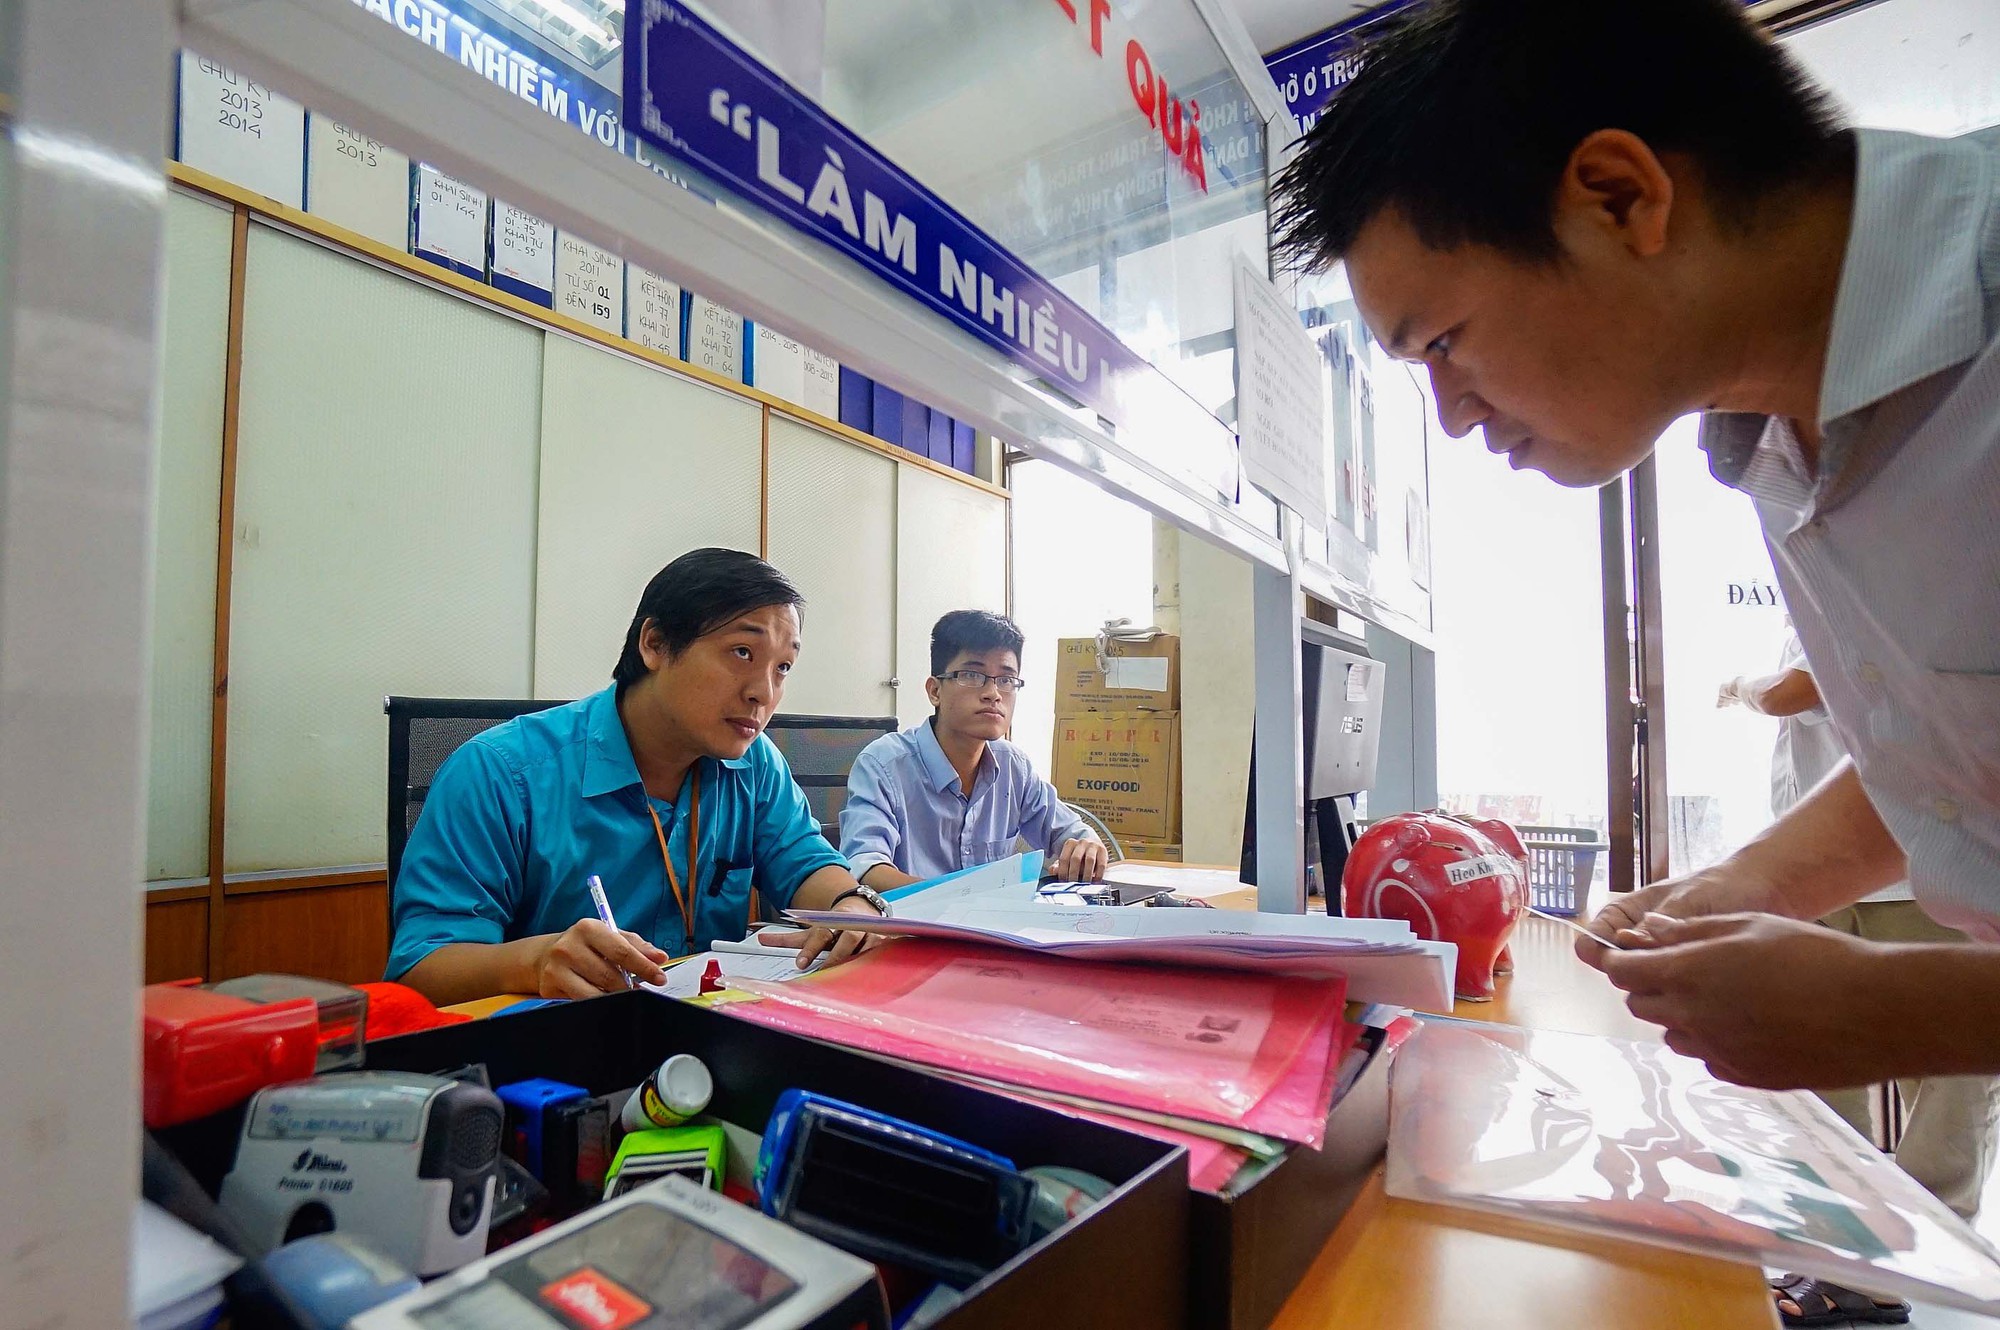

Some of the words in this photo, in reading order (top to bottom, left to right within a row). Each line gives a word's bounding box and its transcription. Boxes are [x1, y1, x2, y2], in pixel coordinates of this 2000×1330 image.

[220, 88, 263, 119] 2013
[218, 109, 261, 140] 2014
[1126, 39, 1209, 196] QUẢ
[336, 139, 377, 167] 2013
[434, 179, 458, 197] KHAI
[459, 189, 483, 209] SINH
[456, 202, 476, 220] 144
[504, 227, 528, 244] KHAI
[525, 246, 537, 257] 55
[563, 239, 588, 258] KHAI
[592, 251, 617, 270] SINH
[579, 260, 600, 277] 2011
[597, 285, 611, 301] 01
[591, 302, 611, 320] 159
[939, 241, 1088, 384] NHIỀU
[639, 313, 658, 333] KHAI
[783, 339, 799, 354] 2015
[722, 361, 733, 376] 64
[1076, 779, 1141, 793] EXOFOOD
[1451, 867, 1476, 883] Heo
